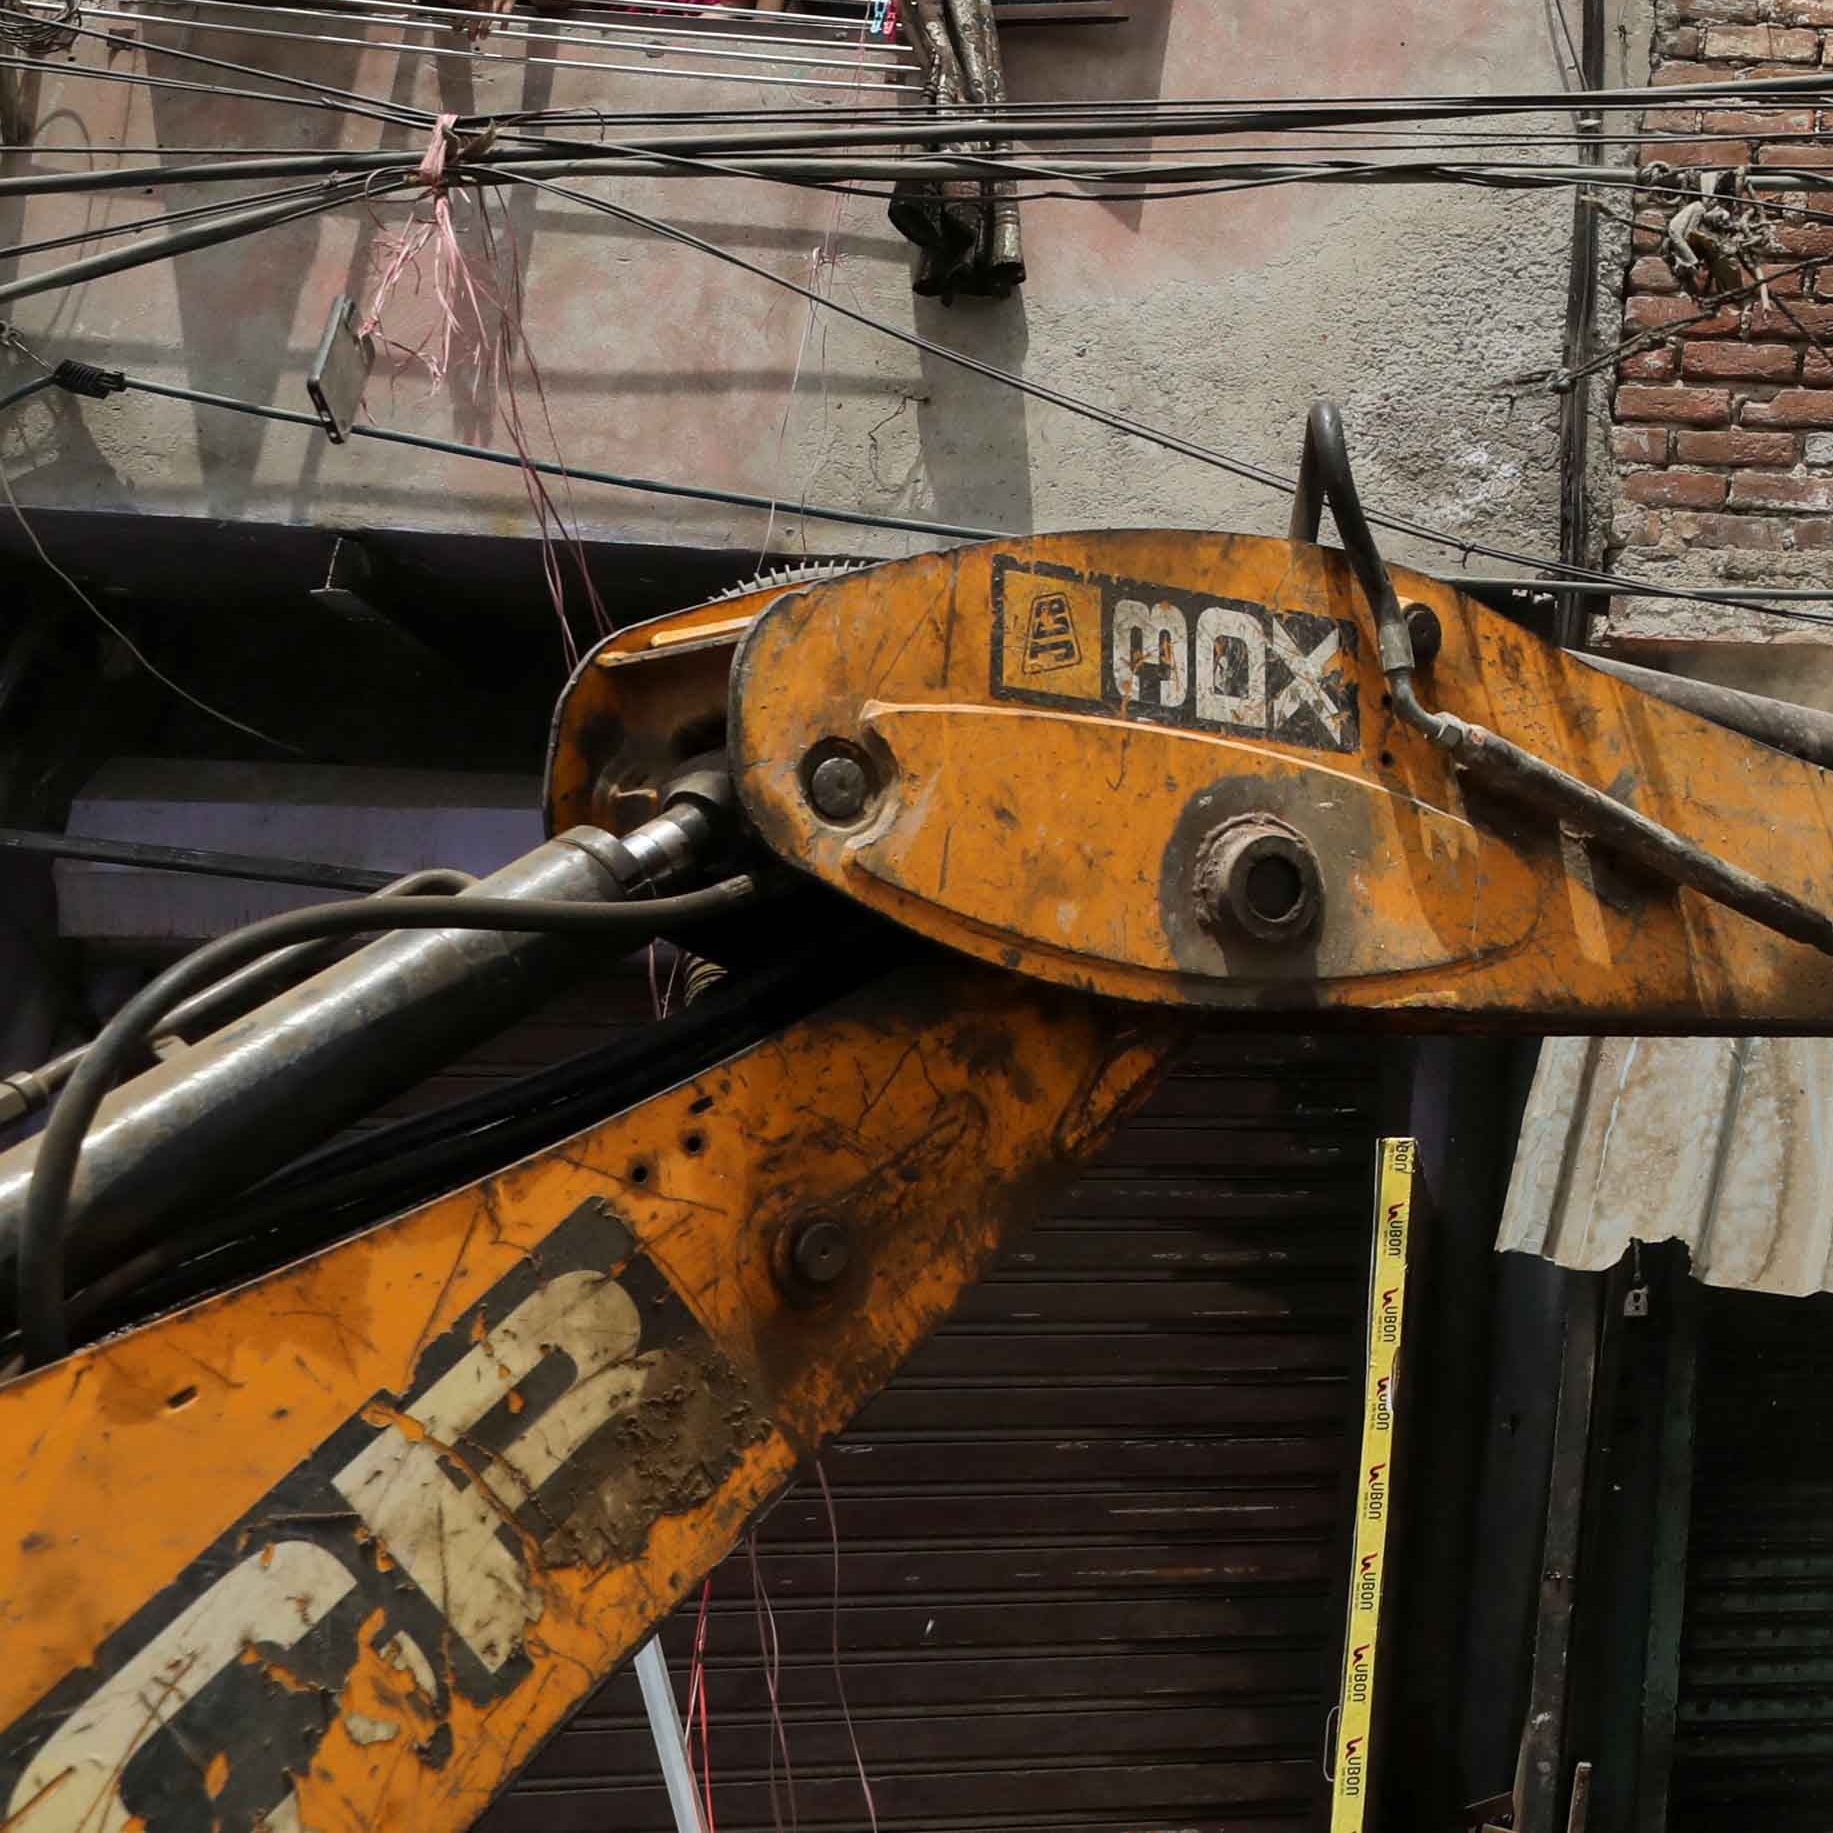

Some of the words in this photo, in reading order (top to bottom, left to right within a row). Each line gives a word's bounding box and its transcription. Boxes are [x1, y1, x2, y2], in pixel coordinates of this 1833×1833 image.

[1028, 597, 1077, 663] JCB
[1387, 1220, 1403, 1257] UBON
[1382, 1305, 1398, 1343] UBON
[1368, 1482, 1384, 1520] UBON
[1360, 1572, 1376, 1610] UBON
[1353, 1663, 1368, 1703] UBON
[1345, 1756, 1361, 1796] UBON
